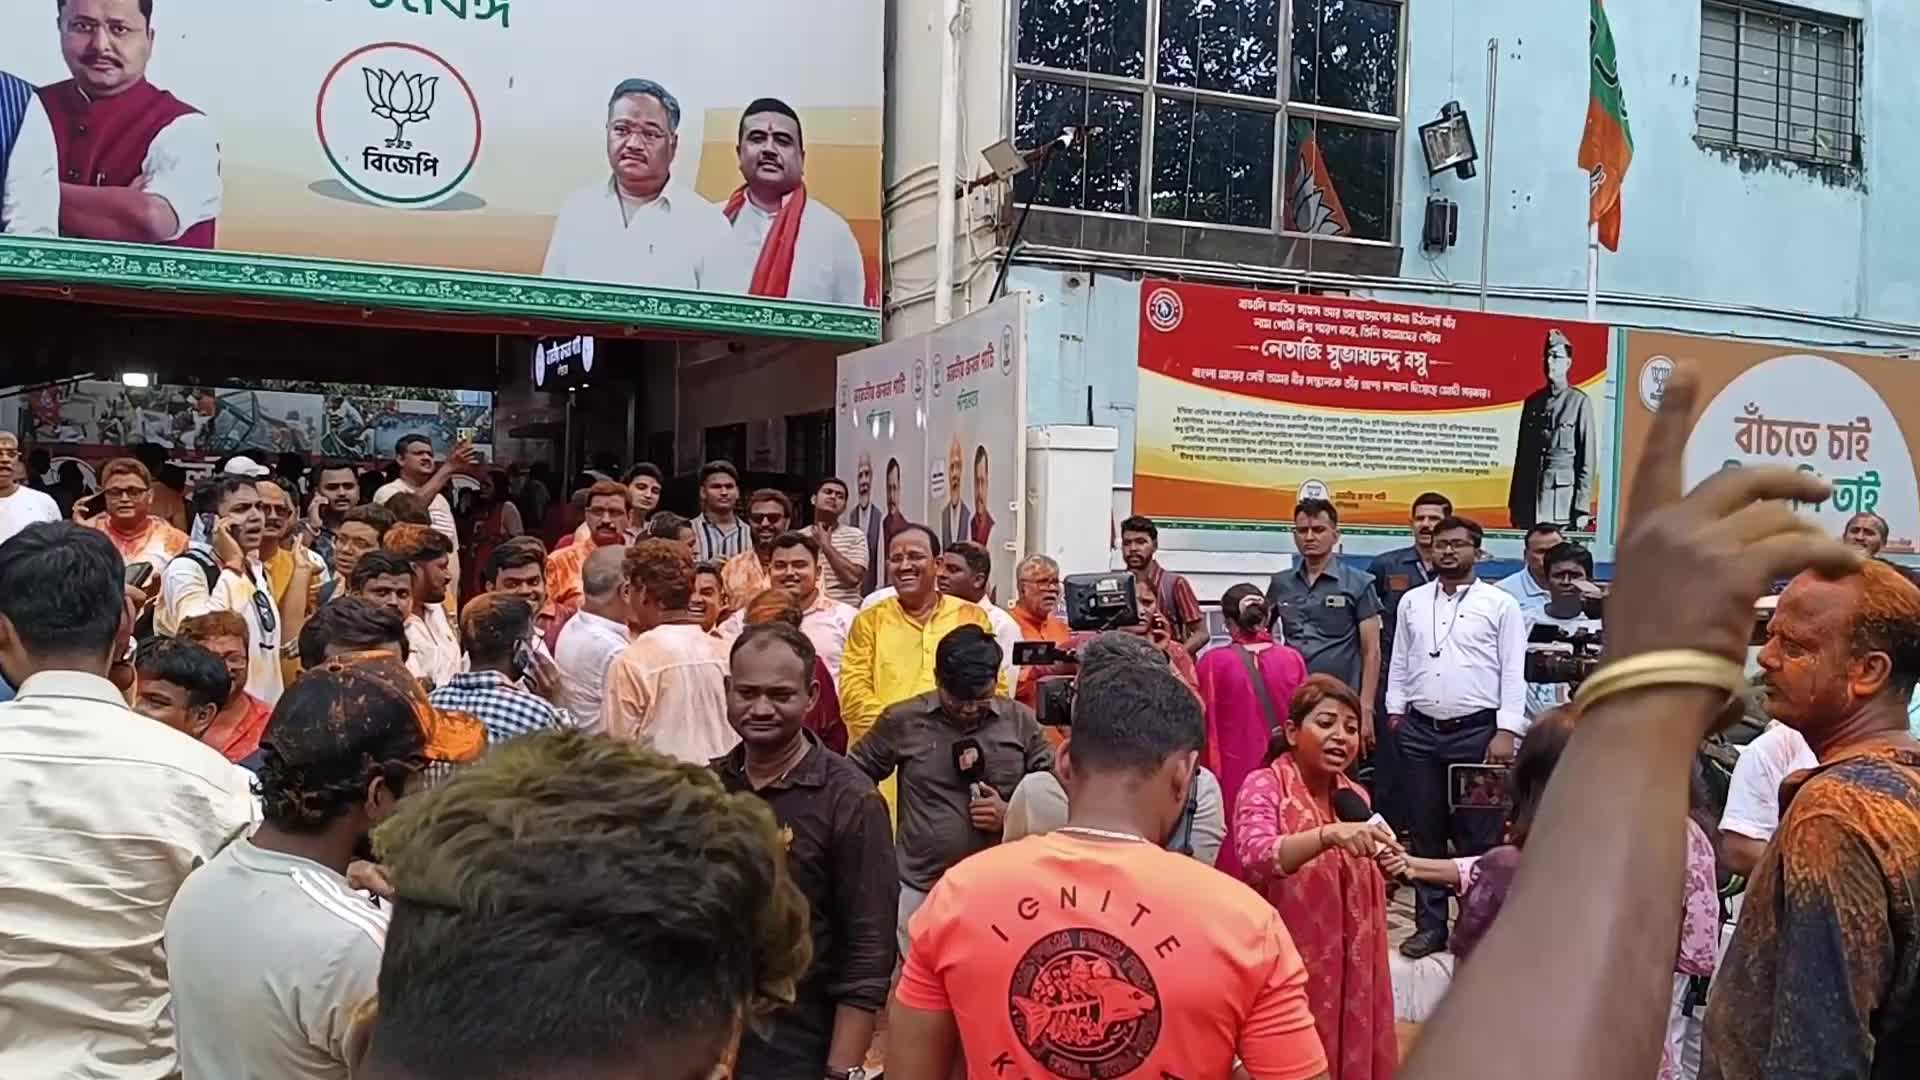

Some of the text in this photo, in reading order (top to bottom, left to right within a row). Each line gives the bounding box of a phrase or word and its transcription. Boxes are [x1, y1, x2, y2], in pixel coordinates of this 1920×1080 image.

[362, 146, 439, 177] বিজেপি
[1261, 336, 1428, 378] নেতাজি সুভাষচন্দ্র বসু
[1734, 402, 1872, 462] বাঁচতে চাই
[1832, 471, 1882, 513] তাই
[991, 885, 1181, 959] IGNITE
